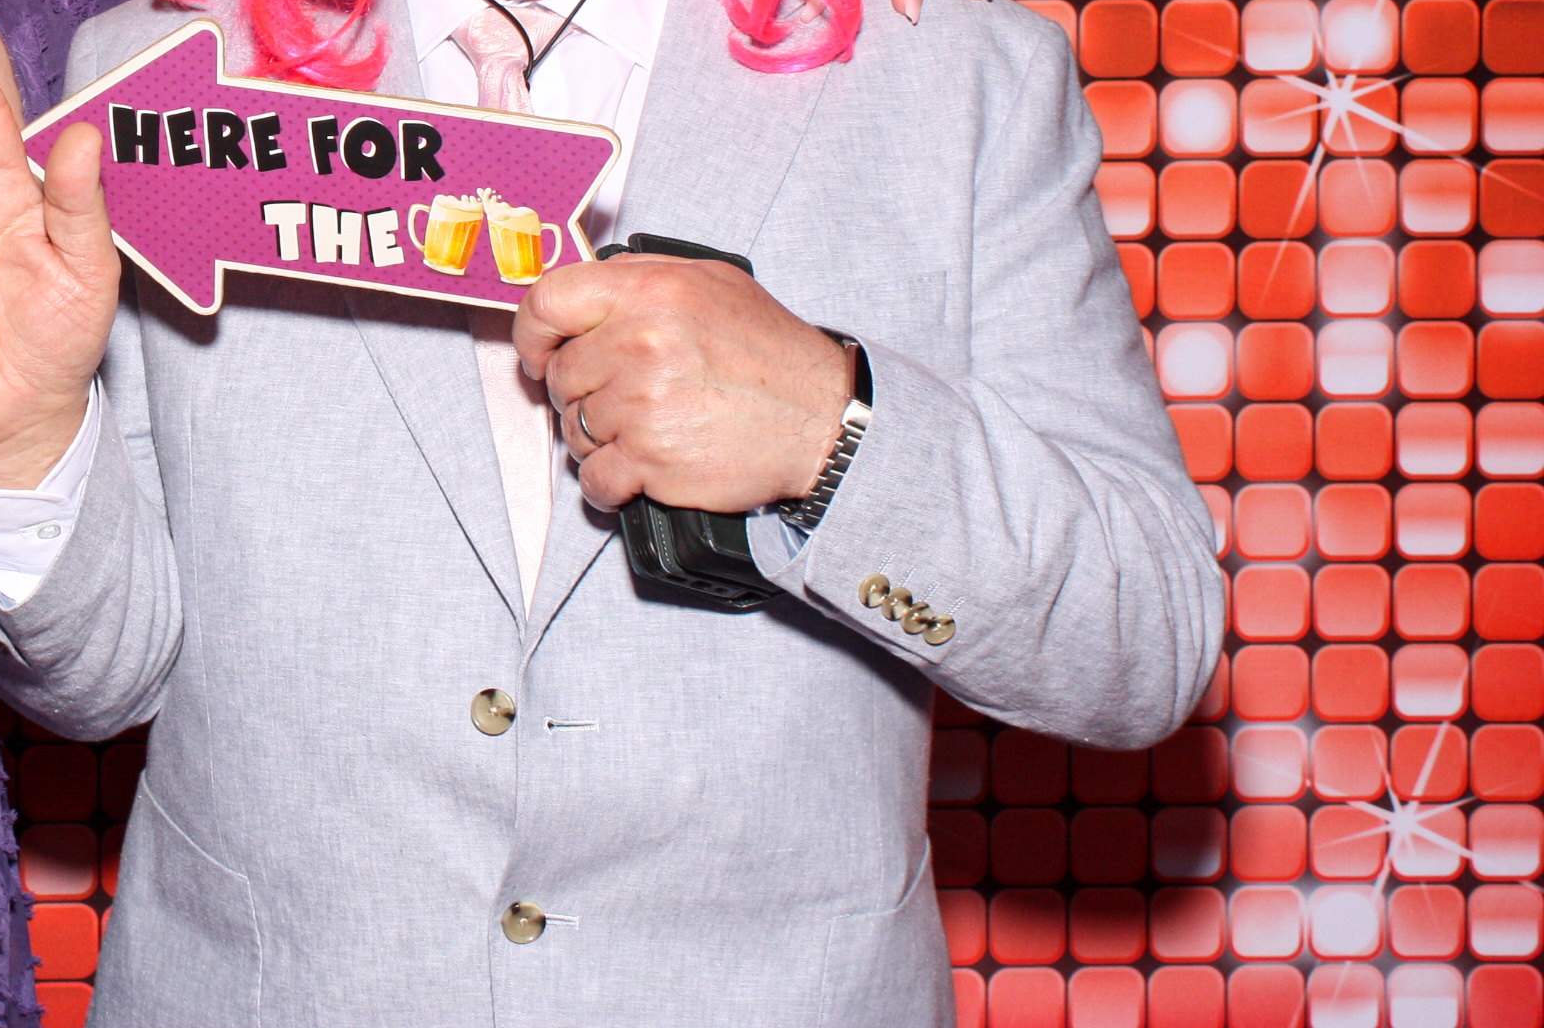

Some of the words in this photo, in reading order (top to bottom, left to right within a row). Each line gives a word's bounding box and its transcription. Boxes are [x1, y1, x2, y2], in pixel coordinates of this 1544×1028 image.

[109, 103, 288, 172] HERE
[307, 115, 446, 182] FOR
[261, 200, 405, 268] THE
